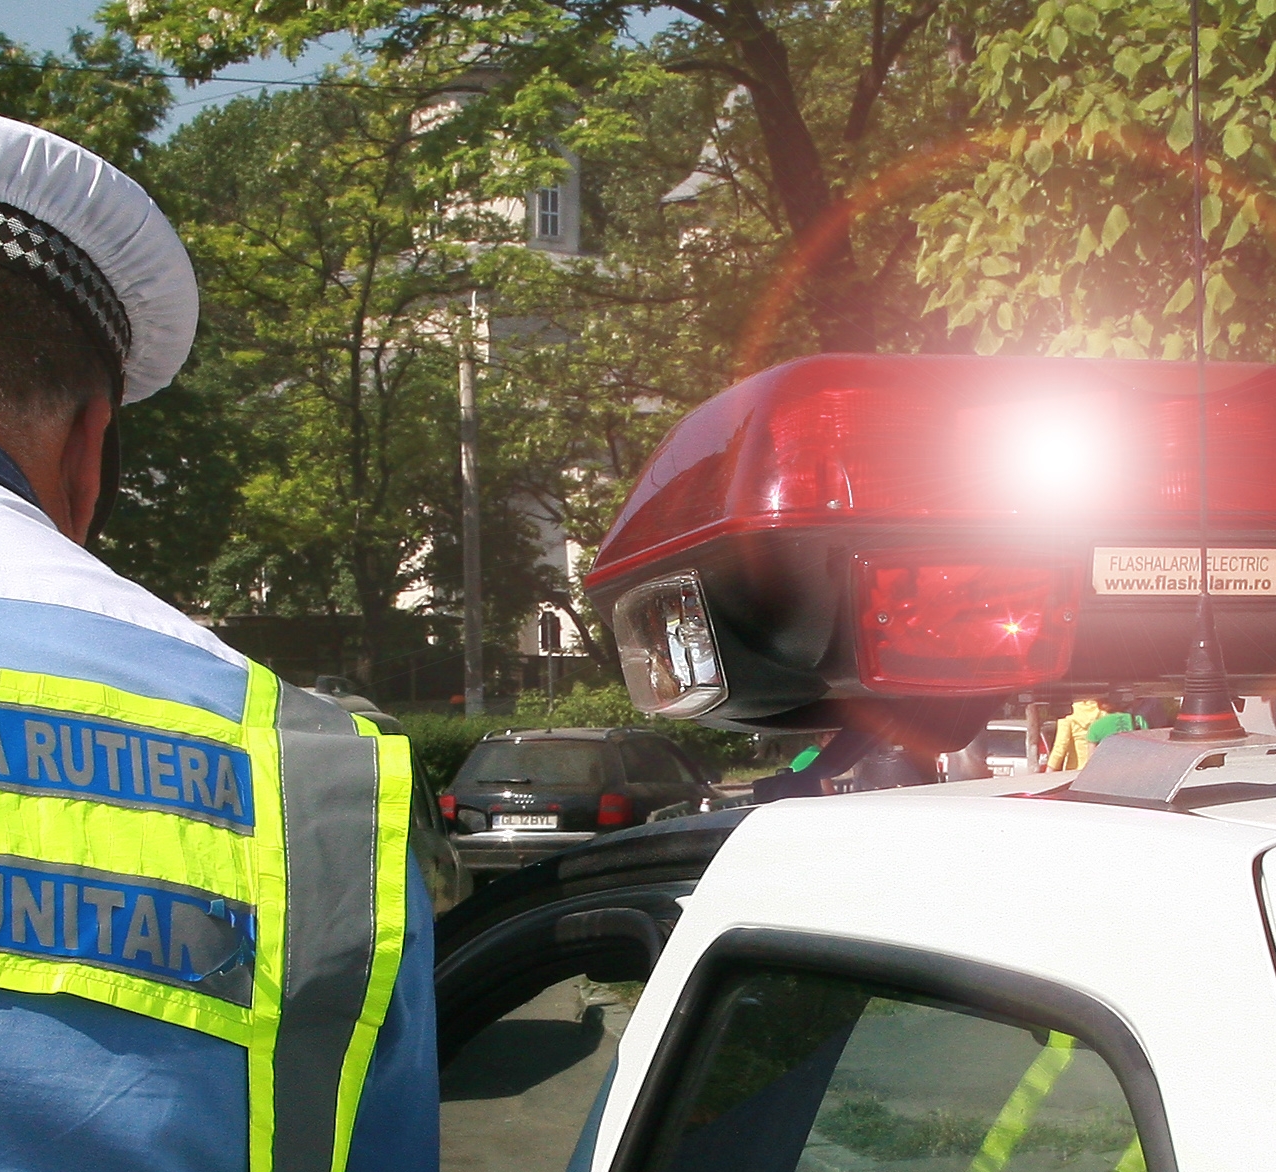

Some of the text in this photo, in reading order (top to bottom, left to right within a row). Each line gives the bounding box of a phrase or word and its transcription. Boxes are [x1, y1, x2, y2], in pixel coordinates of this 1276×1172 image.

[1110, 556, 1269, 571] FLASHALARM ELECTRIC
[25, 719, 244, 817] RUTIERA
